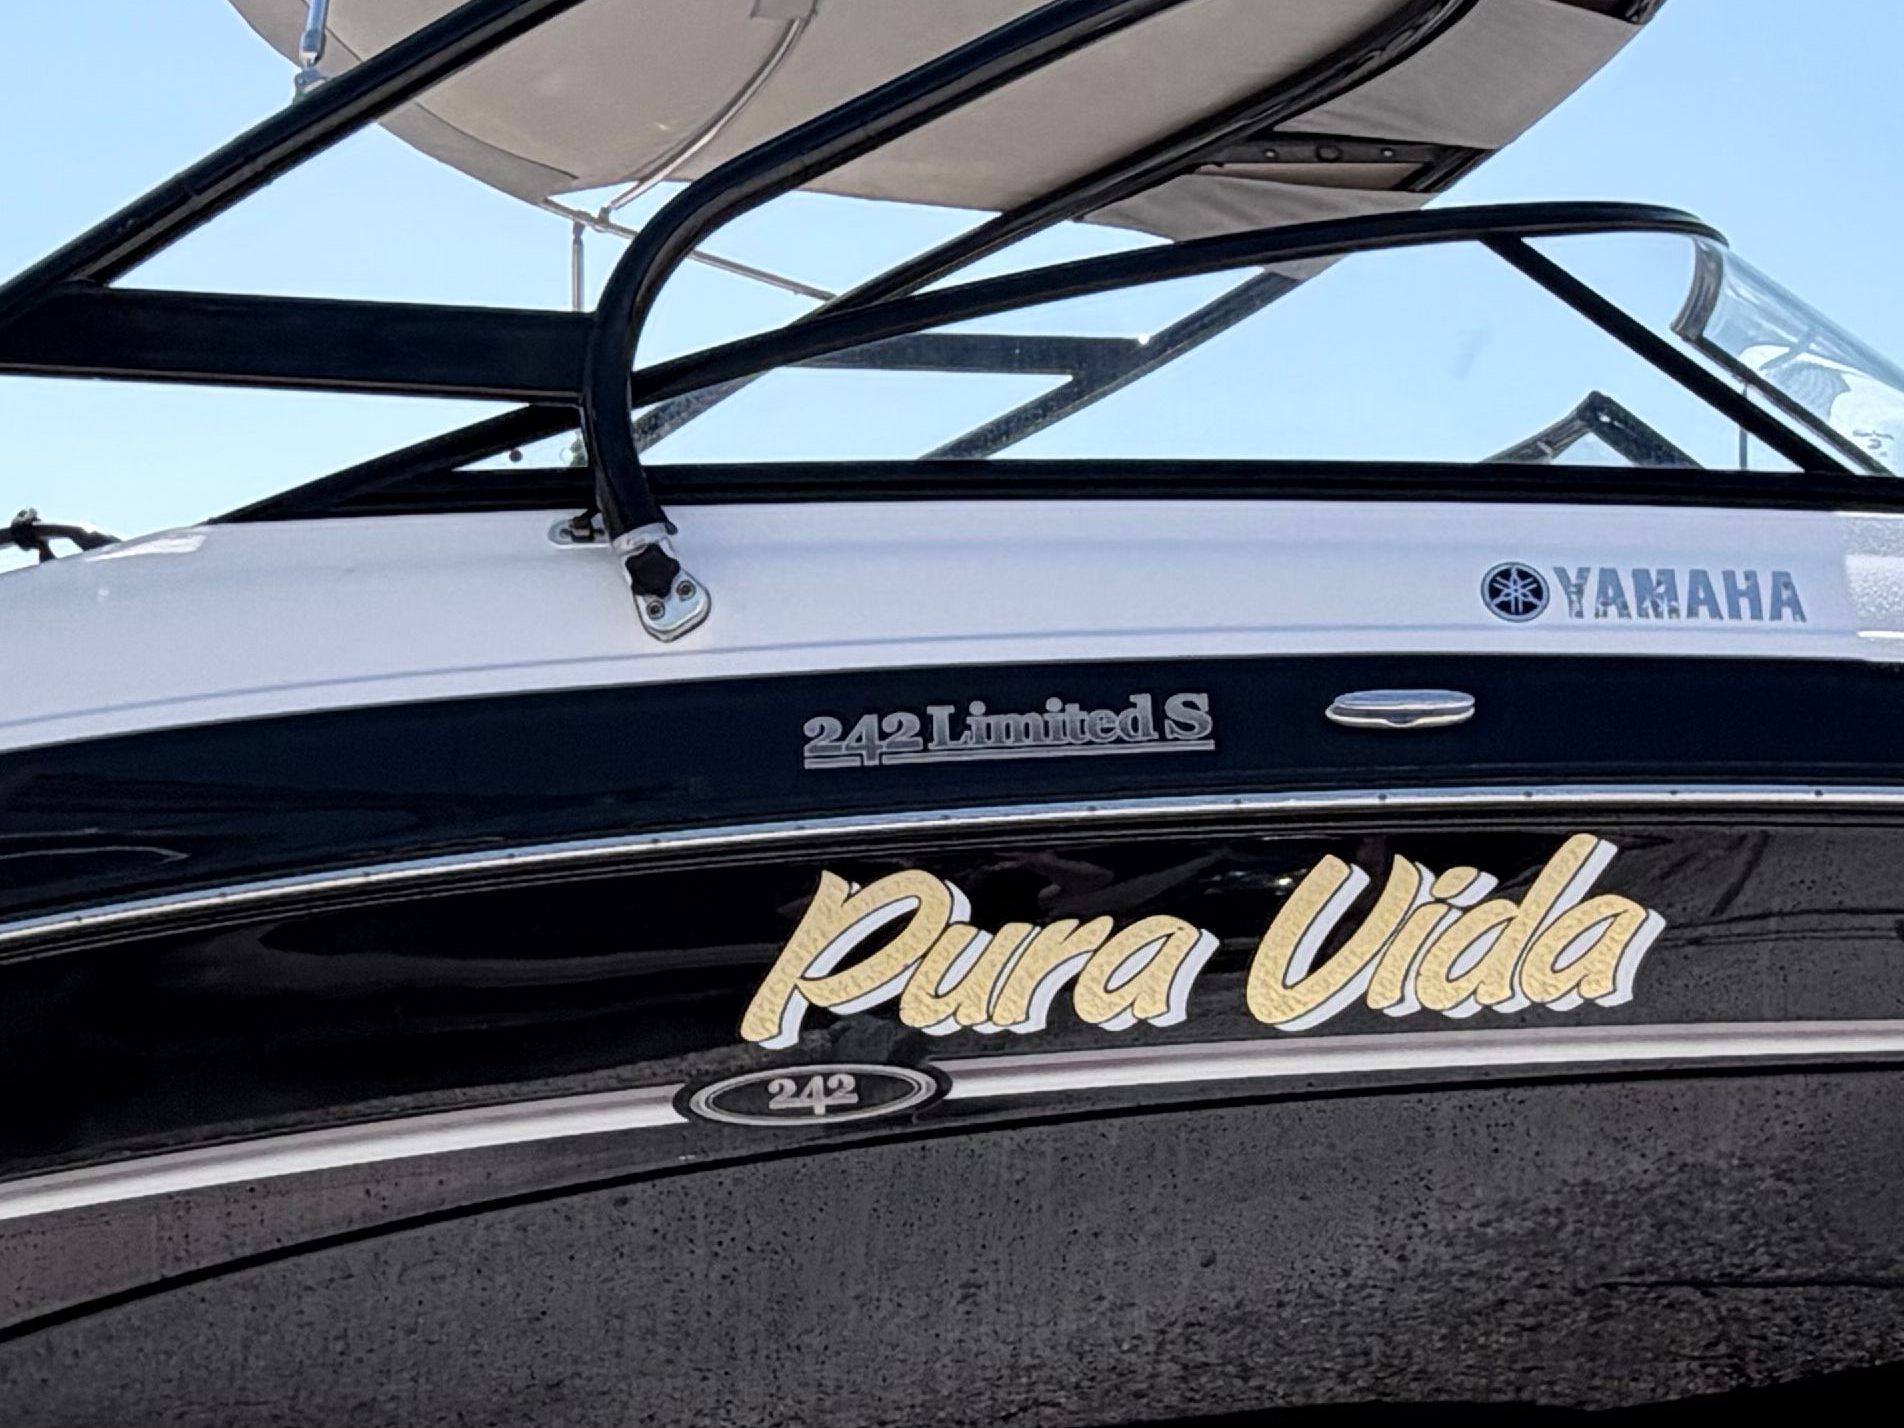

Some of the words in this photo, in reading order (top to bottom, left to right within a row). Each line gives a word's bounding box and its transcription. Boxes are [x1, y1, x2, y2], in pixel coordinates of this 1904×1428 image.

[1552, 566, 1807, 623] YAMAHA
[804, 712, 923, 766] 242
[927, 693, 1159, 750] Limited
[1164, 693, 1214, 740] S
[740, 868, 1219, 1049] Pura
[1246, 833, 1666, 1031] Vida
[767, 1074, 859, 1115] 242
